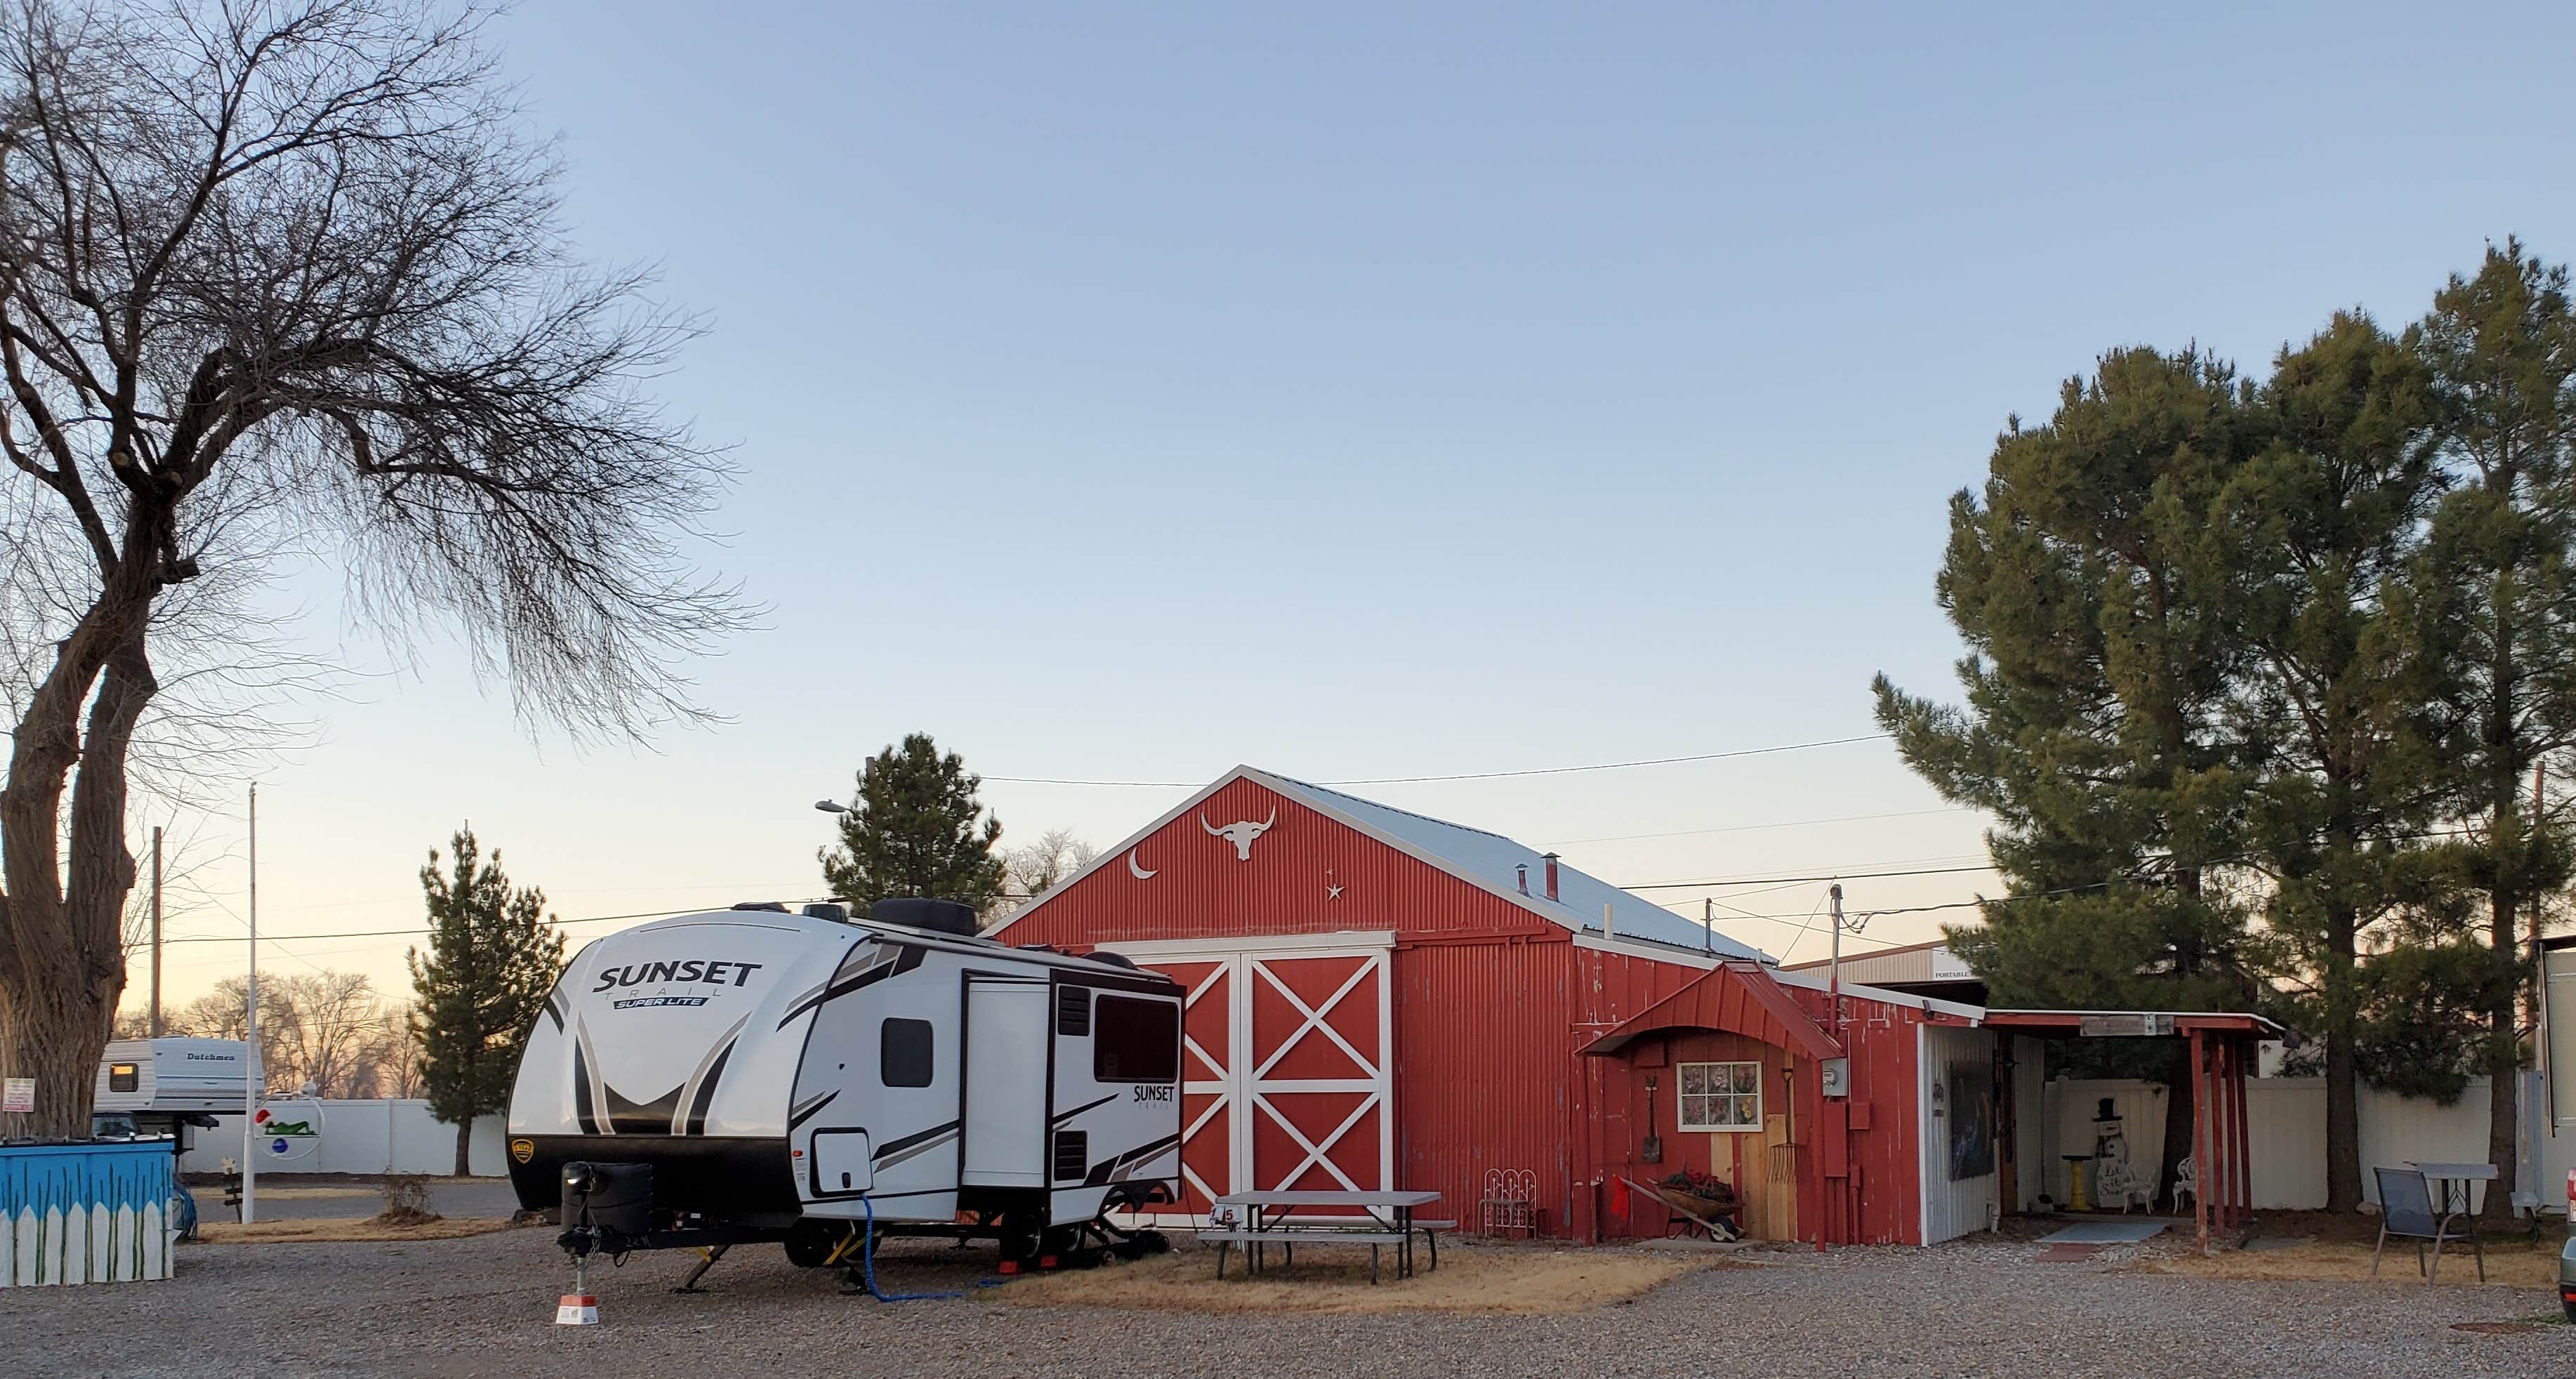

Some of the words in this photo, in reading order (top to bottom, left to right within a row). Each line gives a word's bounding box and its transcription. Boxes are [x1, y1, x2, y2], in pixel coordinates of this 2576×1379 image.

[592, 961, 763, 993] SUNSET
[604, 987, 722, 1001] TRAIL
[616, 999, 663, 1008] SUPER
[666, 998, 703, 1006] LITE
[1134, 1085, 1175, 1102] SUNSET
